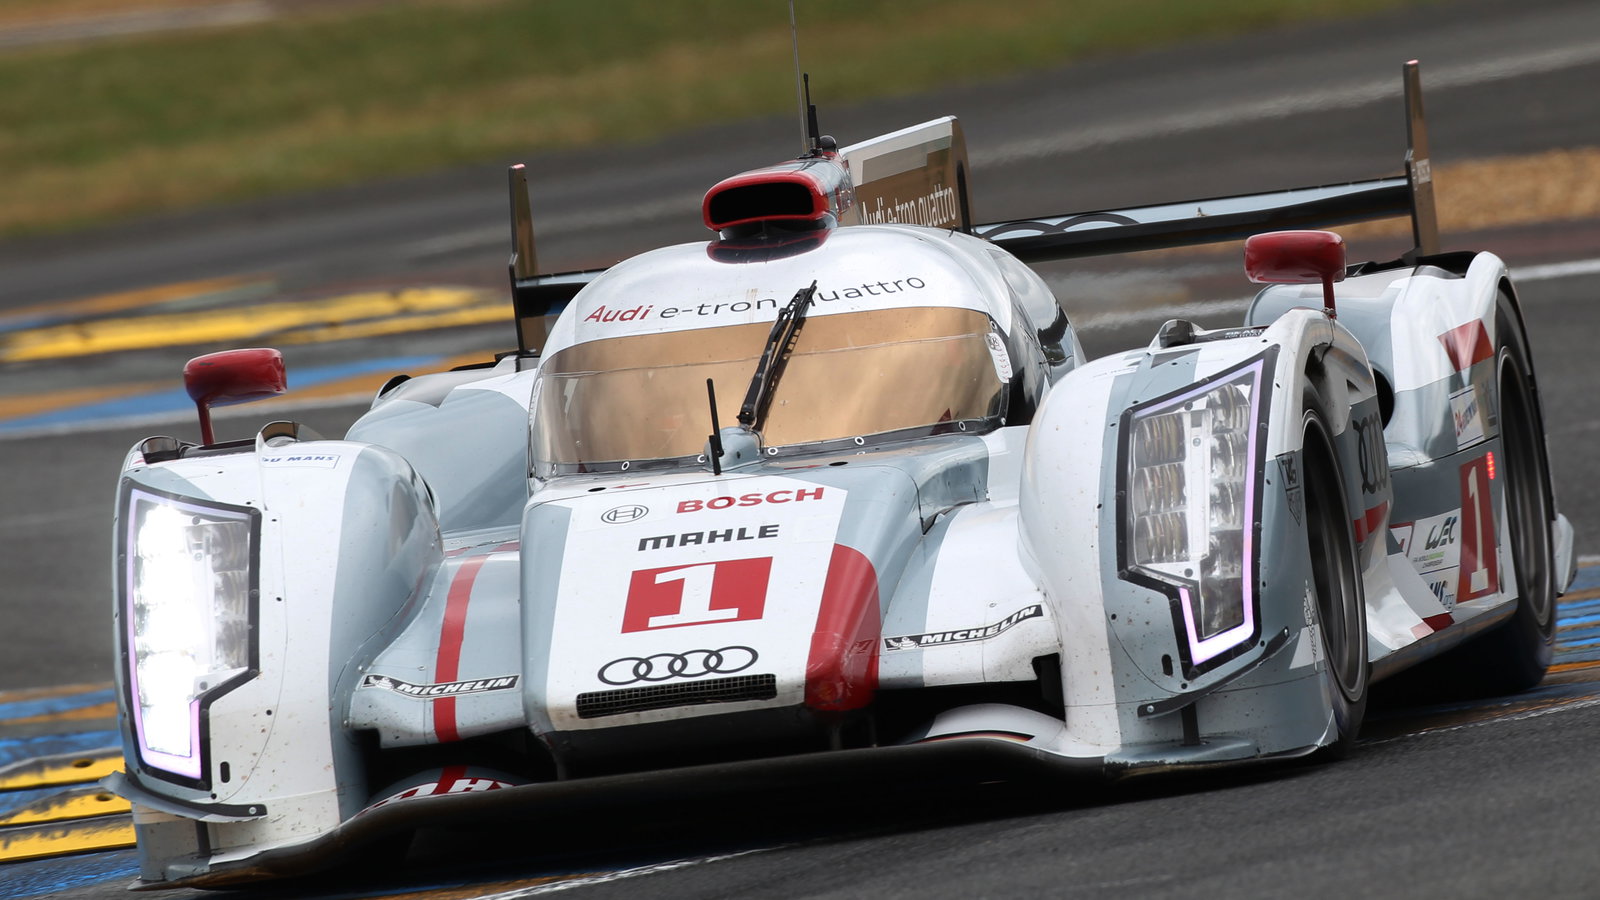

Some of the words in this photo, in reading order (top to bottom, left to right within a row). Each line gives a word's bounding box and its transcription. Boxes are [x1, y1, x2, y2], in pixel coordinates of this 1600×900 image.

[862, 196, 884, 225] Audi
[887, 198, 918, 225] e-tron
[918, 184, 956, 227] quattro
[584, 304, 653, 323] Audi
[659, 298, 777, 319] e-tron
[676, 487, 824, 514] BOSCH
[638, 524, 780, 551] MAHLE
[1425, 516, 1458, 551] WEC
[1468, 466, 1489, 594] 1
[647, 563, 739, 628] 1
[920, 606, 1037, 645] MICHELIN
[398, 676, 514, 696] MICHELIN
